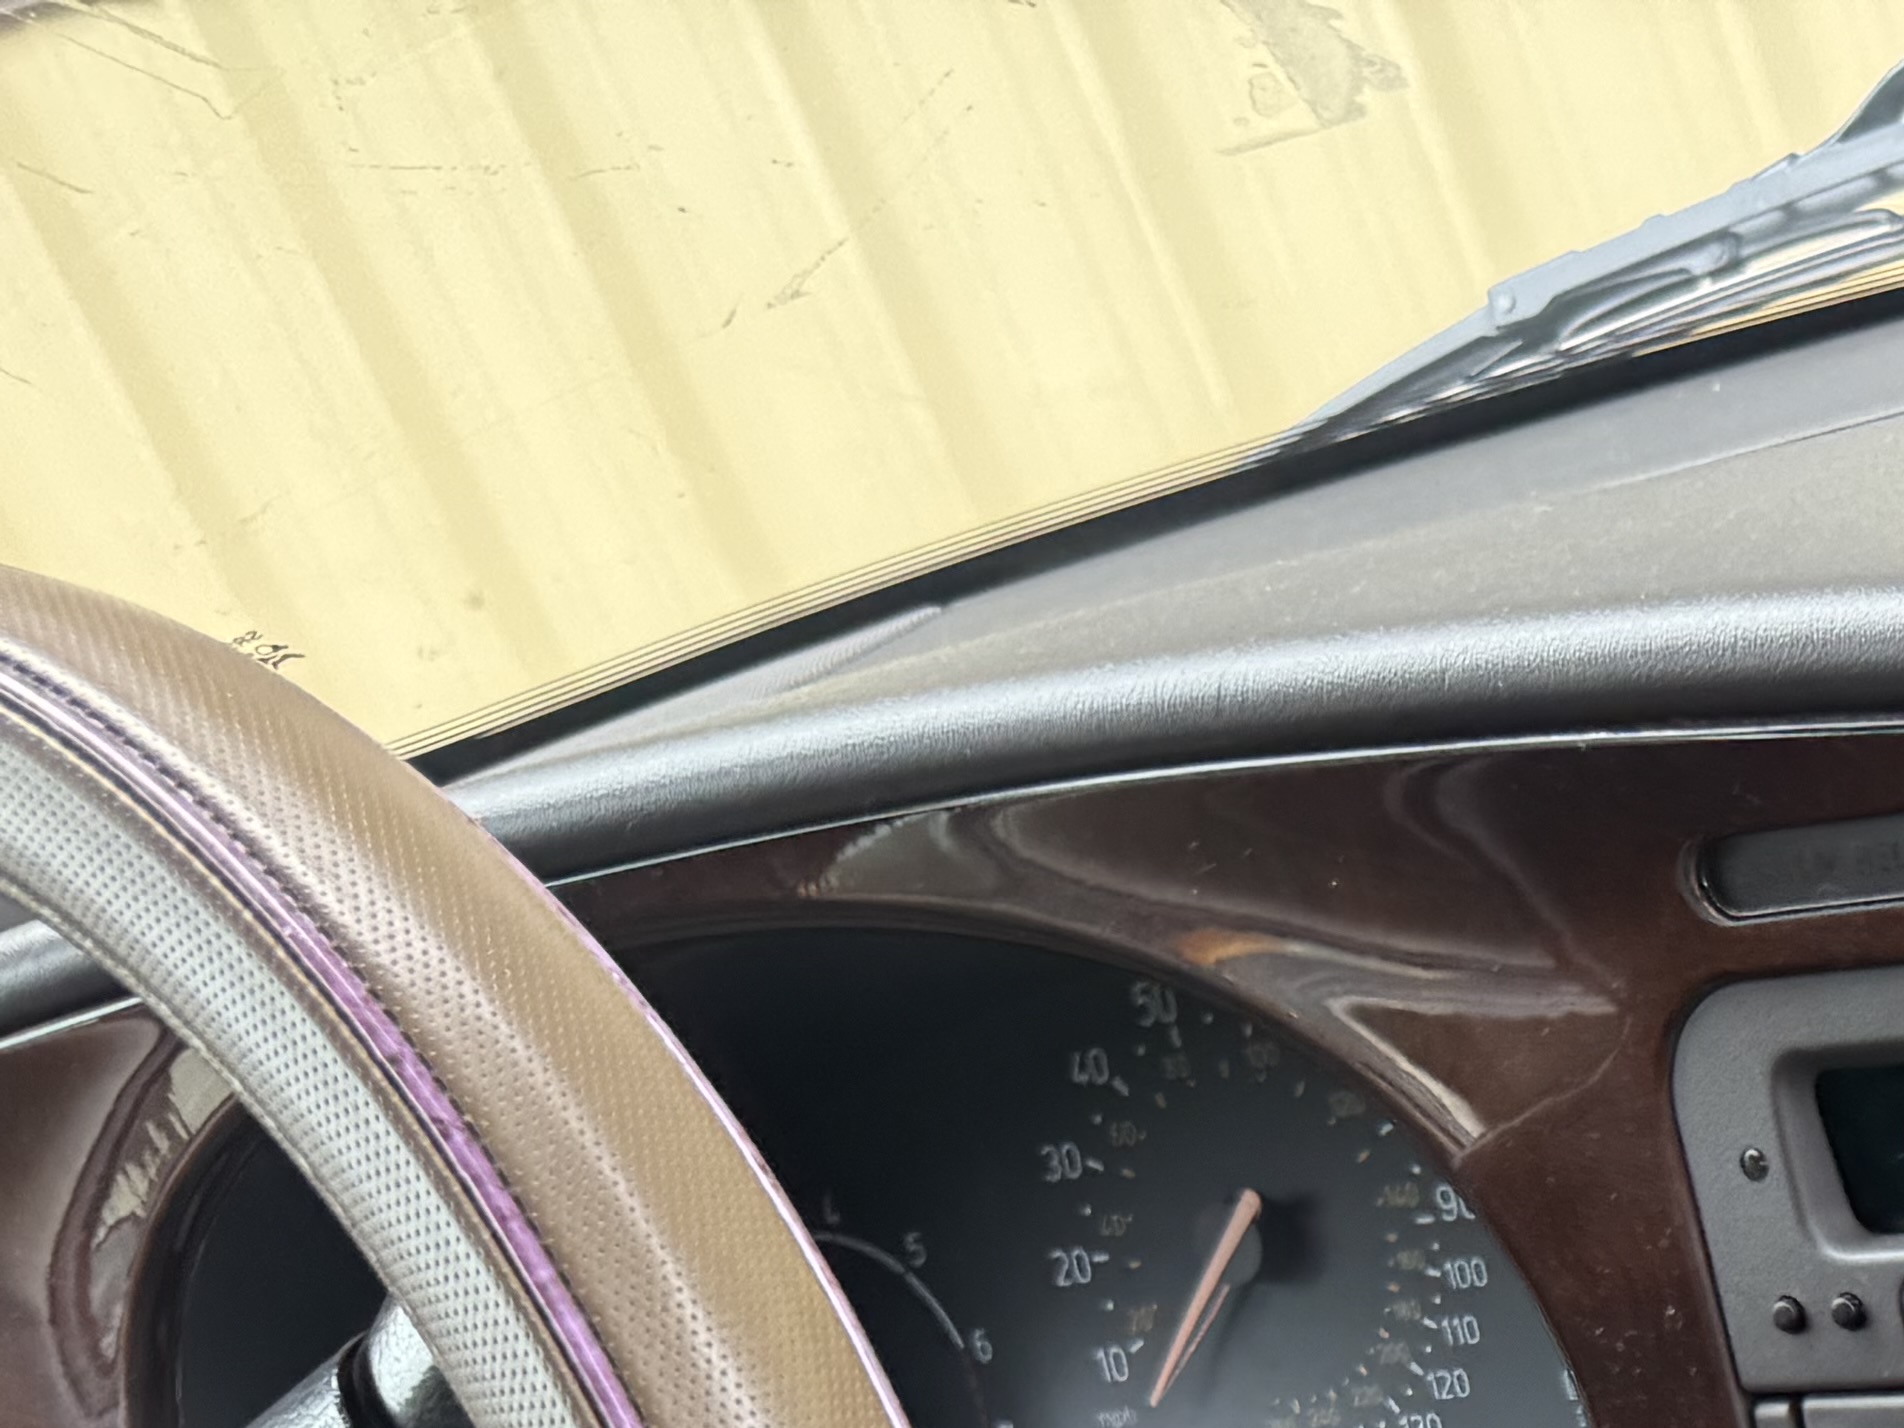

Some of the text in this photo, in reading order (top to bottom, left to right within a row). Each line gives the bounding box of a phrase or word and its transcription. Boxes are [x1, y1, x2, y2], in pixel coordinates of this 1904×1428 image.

[1131, 981, 1178, 1027] 50
[1071, 1048, 1109, 1086] 40
[1041, 1142, 1082, 1183] 30
[903, 1231, 927, 1268] 5
[1050, 1246, 1092, 1287] 20
[1443, 1256, 1488, 1290] 100
[972, 1327, 993, 1365] 6
[1441, 1315, 1481, 1347] 110
[1093, 1347, 1129, 1383] 10
[1426, 1368, 1471, 1400] 120
